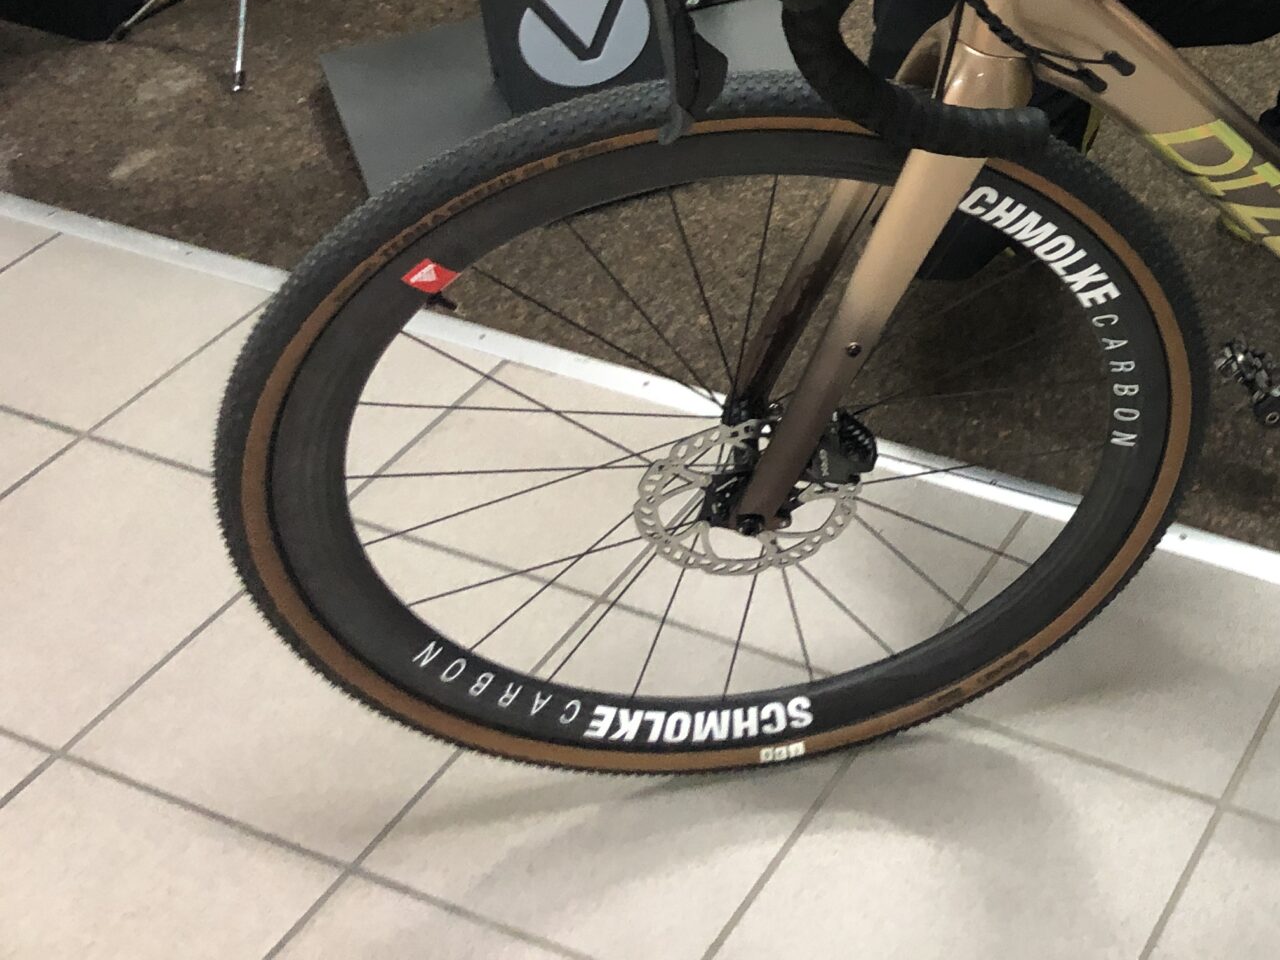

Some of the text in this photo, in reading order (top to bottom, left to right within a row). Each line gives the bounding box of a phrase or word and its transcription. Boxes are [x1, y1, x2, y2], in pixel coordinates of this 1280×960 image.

[958, 186, 1141, 448] CHMOLKE CARBON
[411, 640, 814, 743] SCHMOLKE CARBON
